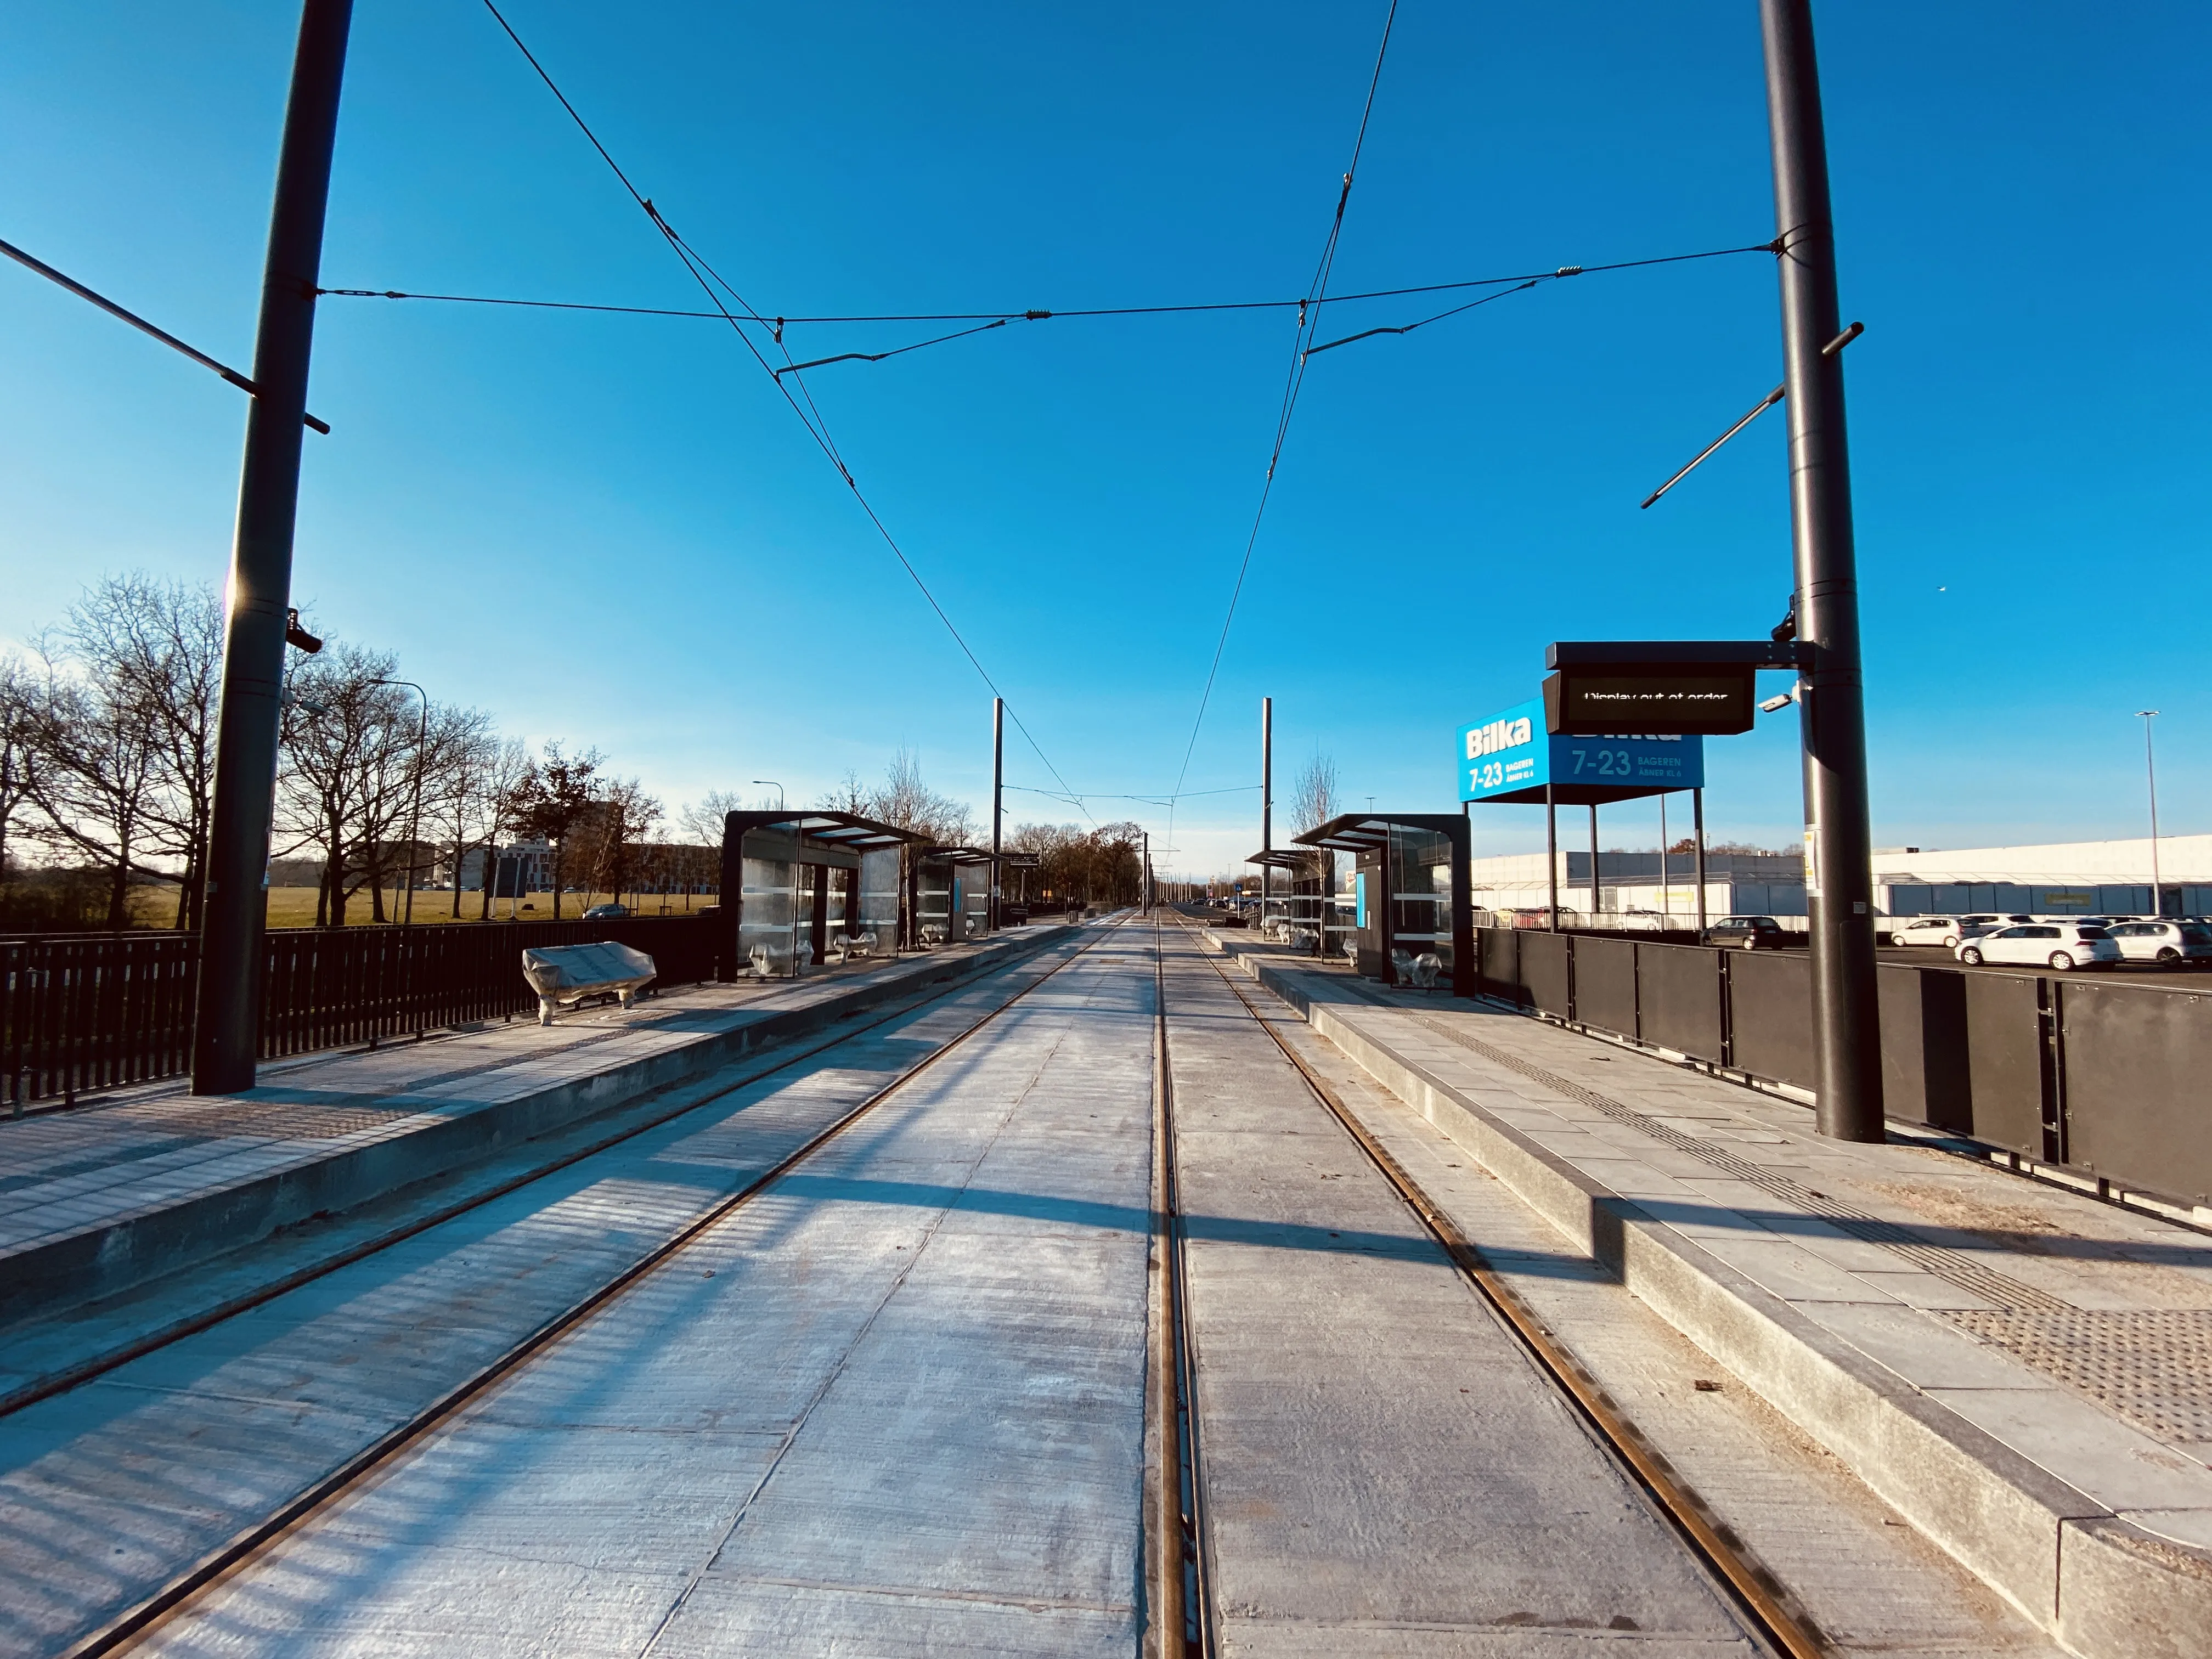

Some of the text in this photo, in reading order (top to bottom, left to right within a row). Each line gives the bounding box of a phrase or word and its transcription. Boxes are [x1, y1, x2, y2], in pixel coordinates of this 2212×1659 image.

[1466, 717, 1533, 760] Bilka
[1505, 758, 1534, 772] BAGEREN
[1572, 750, 1631, 776] 7-23
[1638, 757, 1681, 766] BAGEREN
[1469, 761, 1503, 792] 7-23
[1639, 768, 1664, 776] ÅBNER
